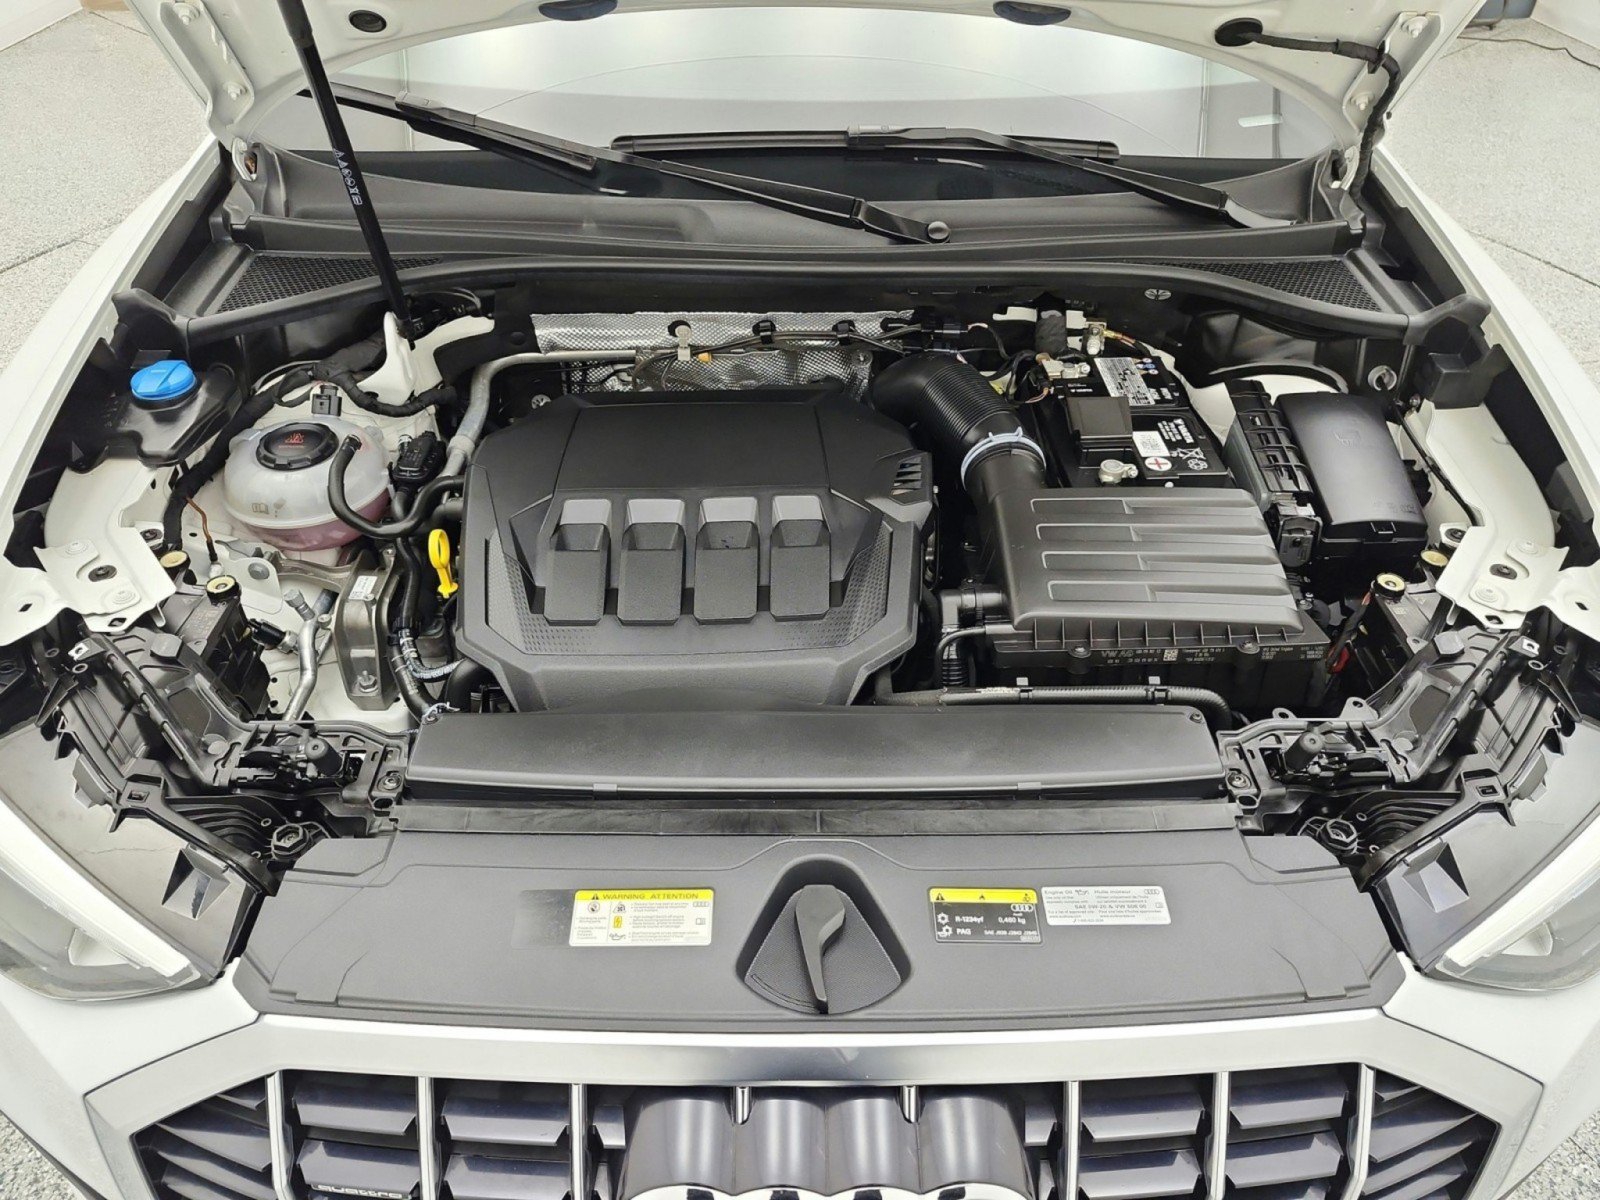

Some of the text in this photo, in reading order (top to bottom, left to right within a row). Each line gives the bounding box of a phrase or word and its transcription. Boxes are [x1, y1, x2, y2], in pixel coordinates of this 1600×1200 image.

[955, 915, 984, 924] R-1234yf
[1017, 916, 1026, 925] kg
[317, 1184, 403, 1199] quattro
